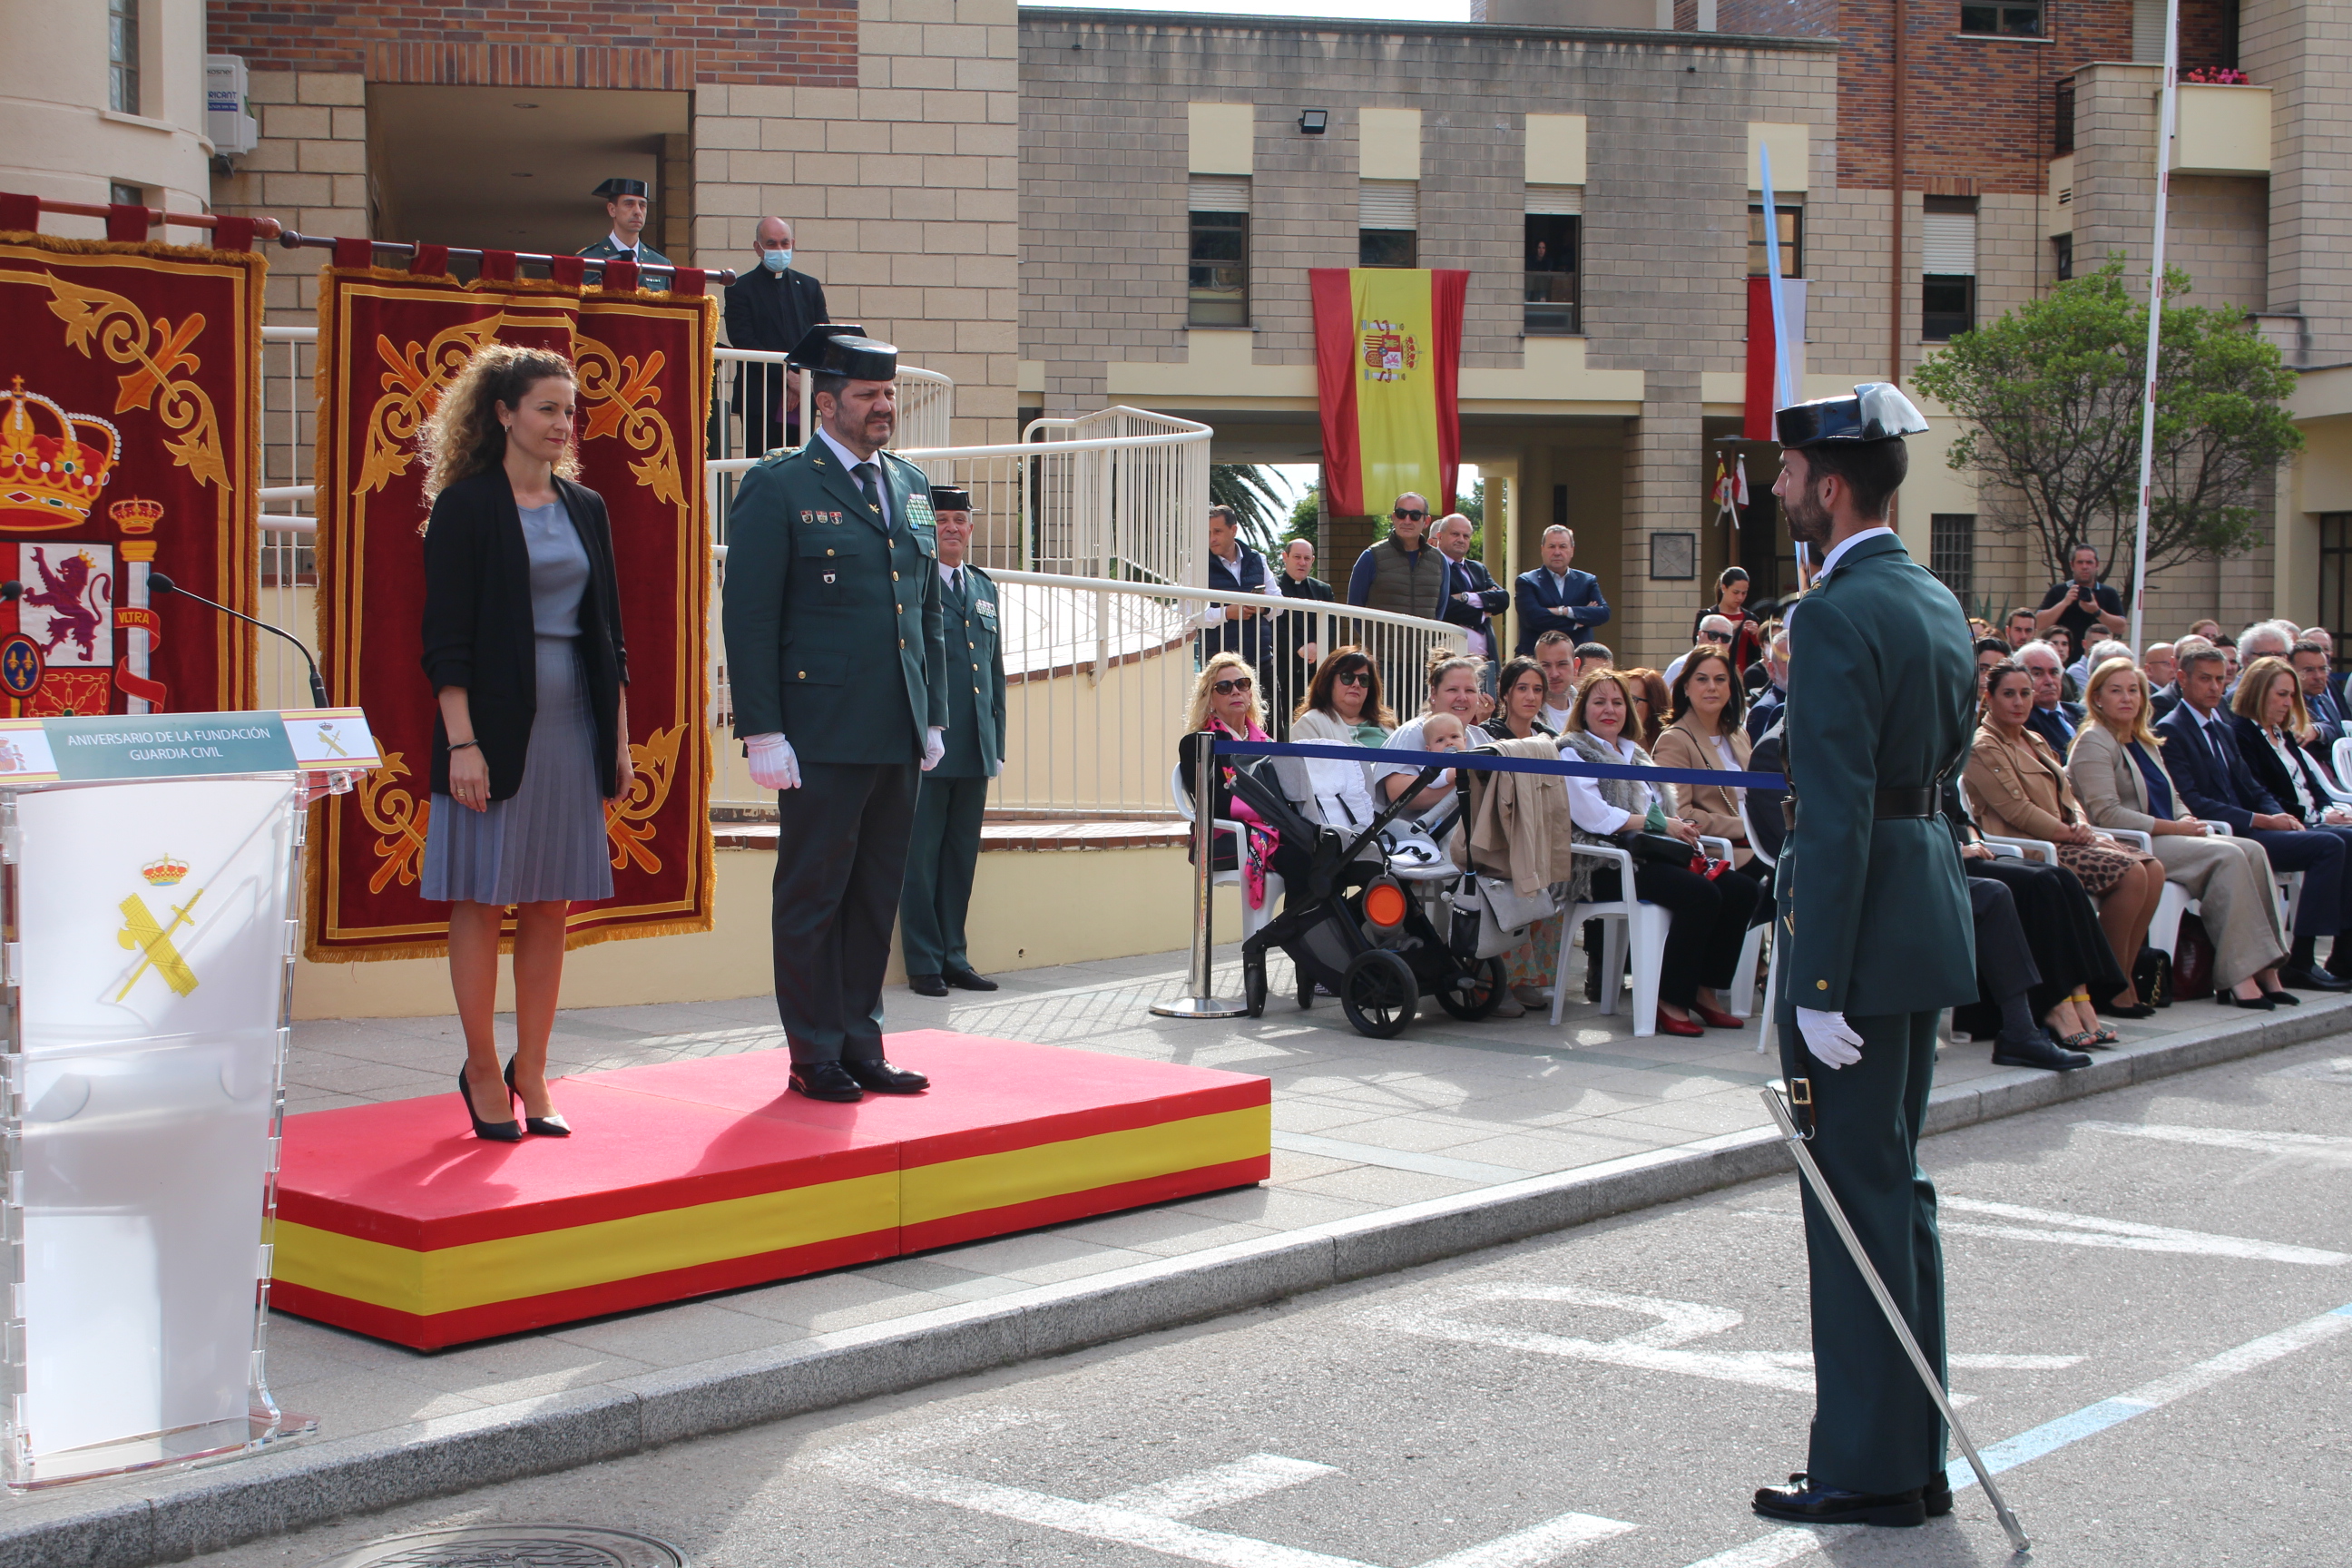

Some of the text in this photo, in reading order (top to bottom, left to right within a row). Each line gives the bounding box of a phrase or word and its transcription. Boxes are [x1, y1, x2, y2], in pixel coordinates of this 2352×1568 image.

[118, 612, 150, 624] VLTRA
[68, 727, 271, 746] ANIVERSARIO DE LA FUNDACIÓN
[130, 746, 223, 760] GUARDIA CIVIL
